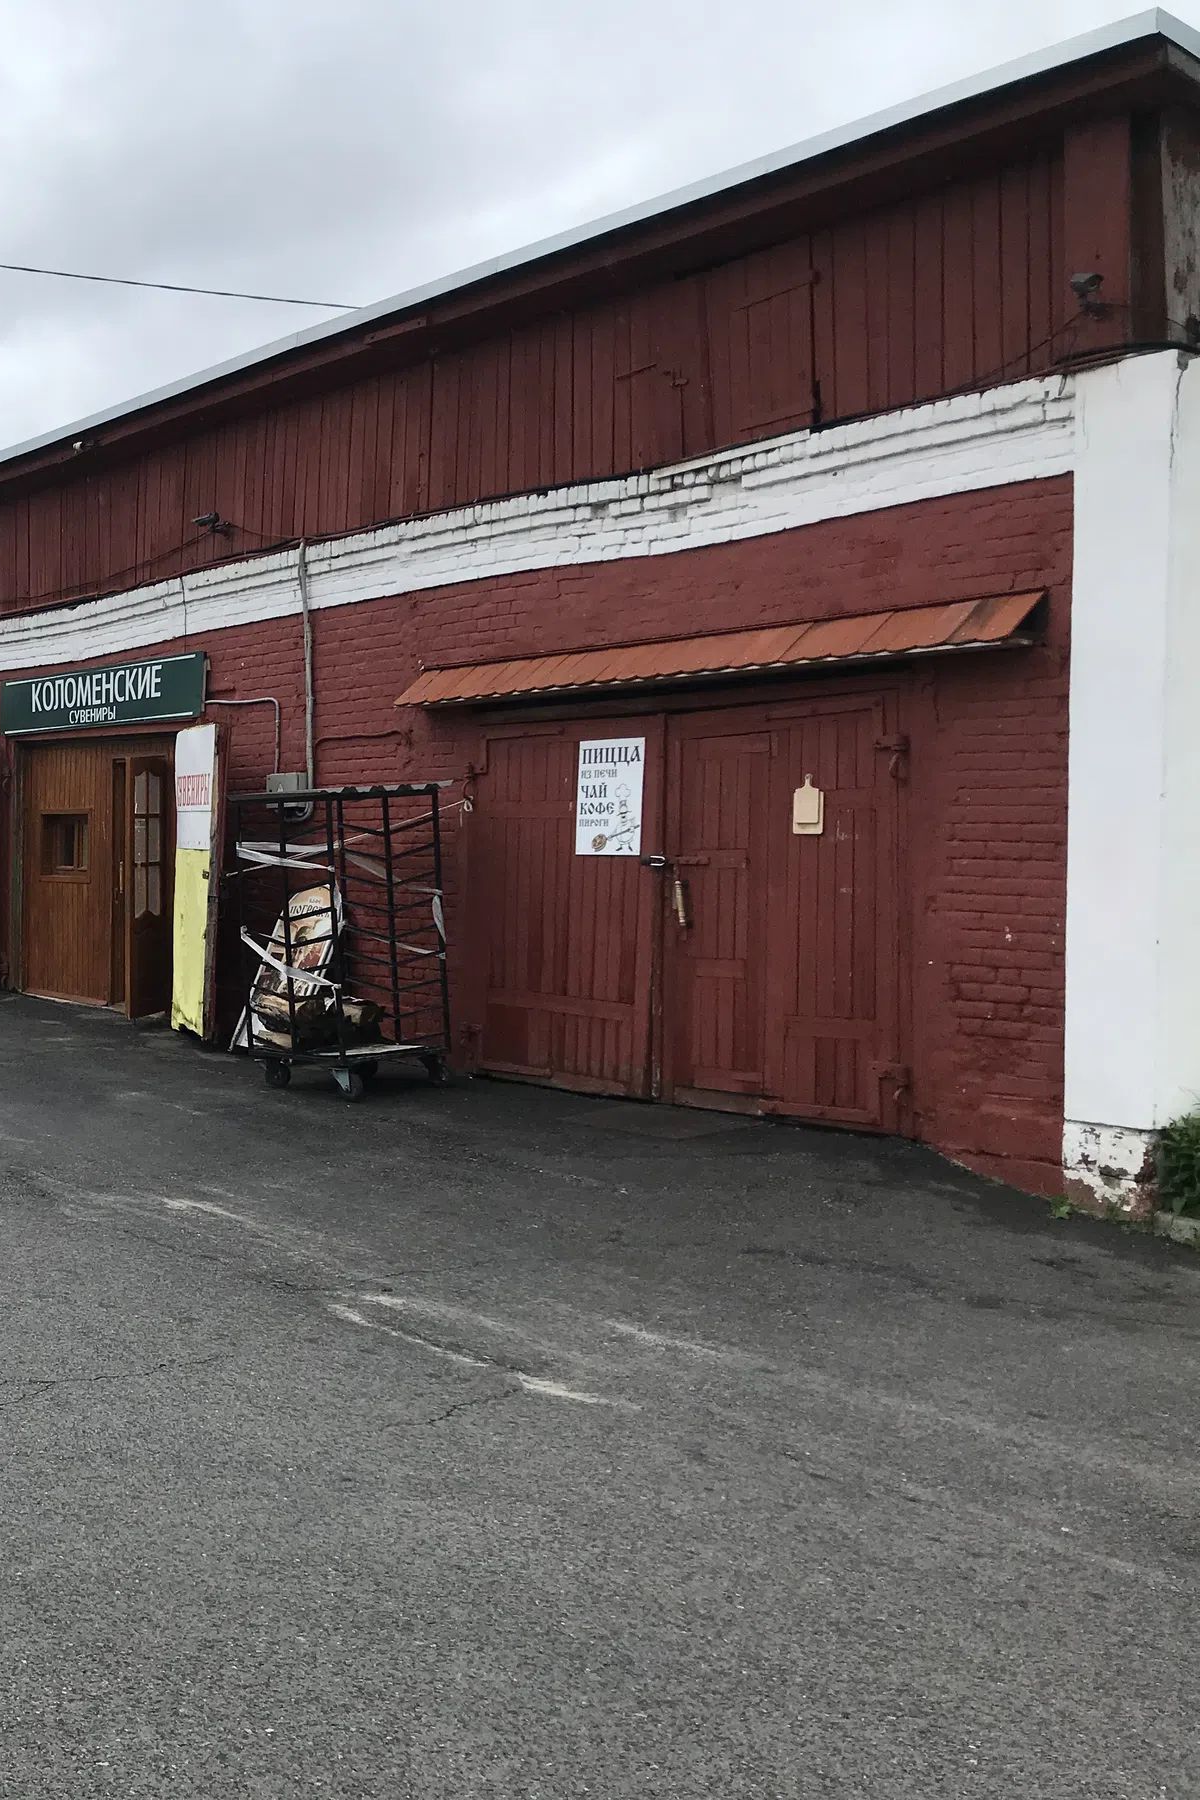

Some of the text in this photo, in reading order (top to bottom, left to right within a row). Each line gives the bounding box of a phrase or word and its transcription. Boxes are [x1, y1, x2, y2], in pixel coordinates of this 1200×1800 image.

[31, 664, 163, 713] КОЛОМЕНСКИЕ
[69, 705, 116, 724] СУВЕНИРЫ
[582, 745, 641, 767] ПИЦЦА
[581, 768, 618, 779] ИЗ ПЕЧИ
[581, 782, 607, 798] ЧАЙ
[580, 802, 615, 815] КОФЕ
[579, 819, 609, 827] ПИРОГИ
